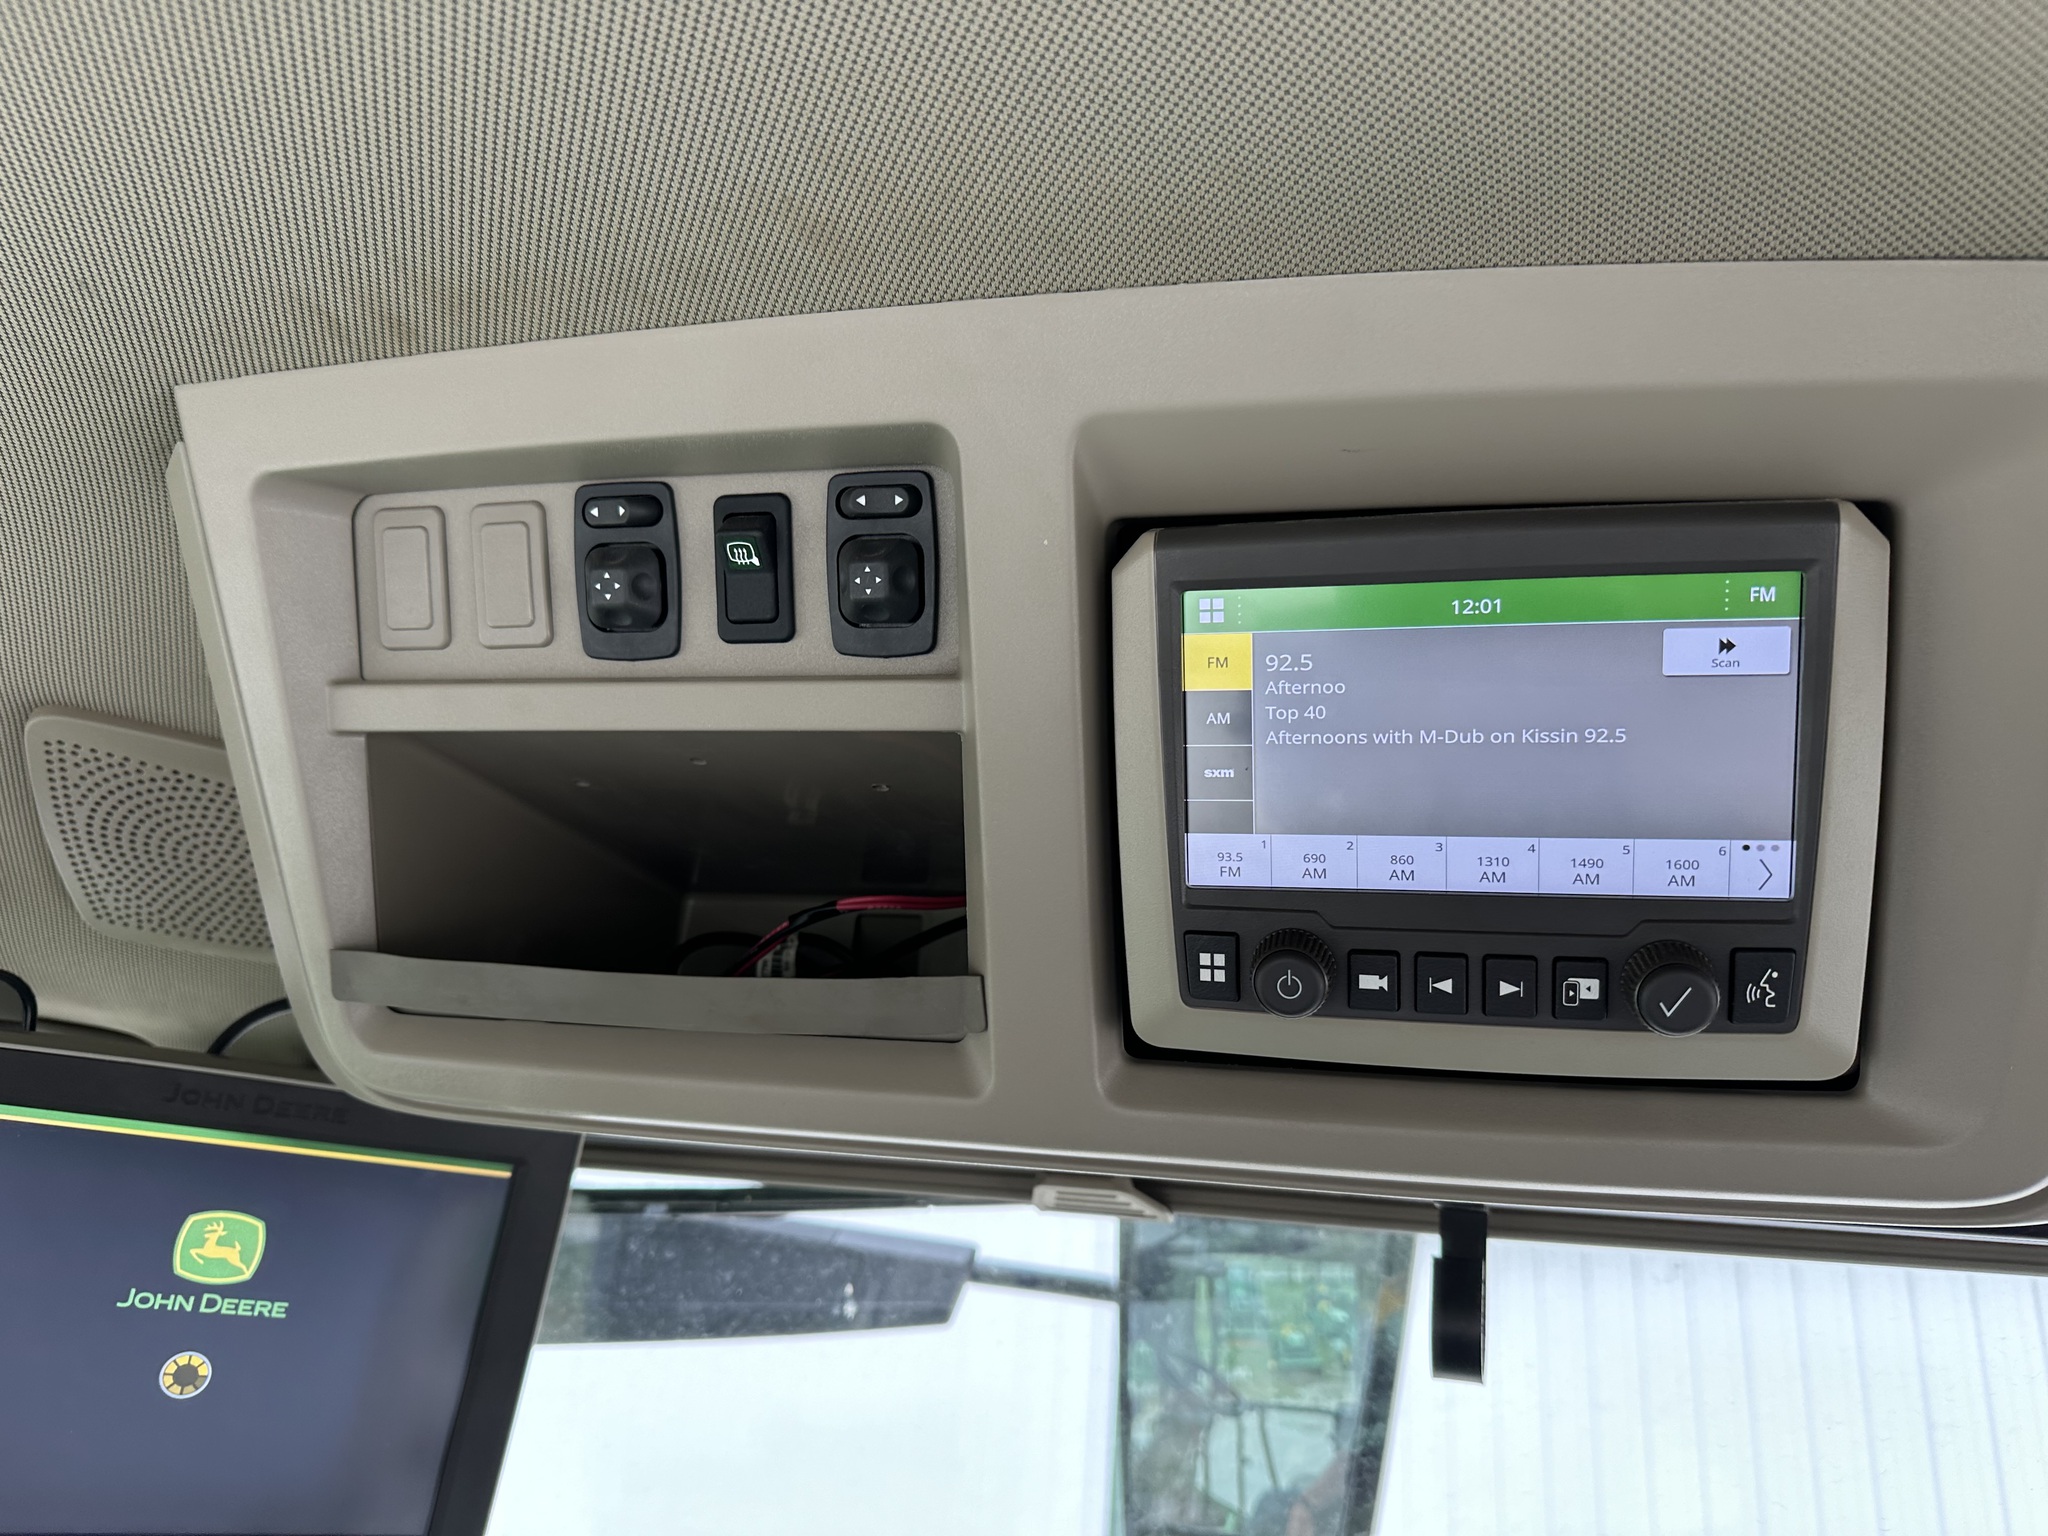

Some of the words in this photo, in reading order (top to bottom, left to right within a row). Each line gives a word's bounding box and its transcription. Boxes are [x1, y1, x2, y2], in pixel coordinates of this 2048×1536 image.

[1750, 586, 1776, 602] FM
[1451, 598, 1502, 615] 12:01
[1207, 656, 1229, 669] FM
[1265, 654, 1313, 672] 92.5
[1711, 657, 1740, 669] Scan
[1265, 680, 1346, 695] Afternoo
[1206, 712, 1231, 725] AM
[1265, 705, 1299, 724] Top
[1303, 705, 1327, 720] 40
[1265, 730, 1368, 745] Afternoons
[1373, 729, 1413, 745] with
[1420, 728, 1484, 744] M-Dub
[1490, 730, 1515, 744] on
[1522, 728, 1579, 744] Kissin
[1584, 727, 1627, 744] 92.5
[1204, 768, 1235, 778] sxm
[1261, 840, 1267, 850] 1
[1346, 841, 1354, 851] 2
[1435, 842, 1443, 852] 3
[1527, 843, 1536, 854] 4
[1622, 845, 1631, 855] 5
[1217, 852, 1243, 863] 93.5
[1718, 846, 1727, 857] 6
[1303, 853, 1326, 864] 690
[1390, 854, 1414, 866] 860
[1477, 856, 1510, 868] 1310
[1570, 857, 1604, 869] 1490
[1666, 859, 1700, 871] 1600
[1220, 866, 1241, 878] FM
[1302, 868, 1327, 880] AM
[1389, 869, 1415, 881] AM
[1479, 871, 1506, 884] AM
[1572, 873, 1600, 885] AM
[1667, 875, 1696, 887] AM
[162, 1083, 247, 1112] JOHN
[252, 1094, 349, 1125] DEERE
[116, 1288, 195, 1312] JOHN
[199, 1293, 289, 1319] DEERE
